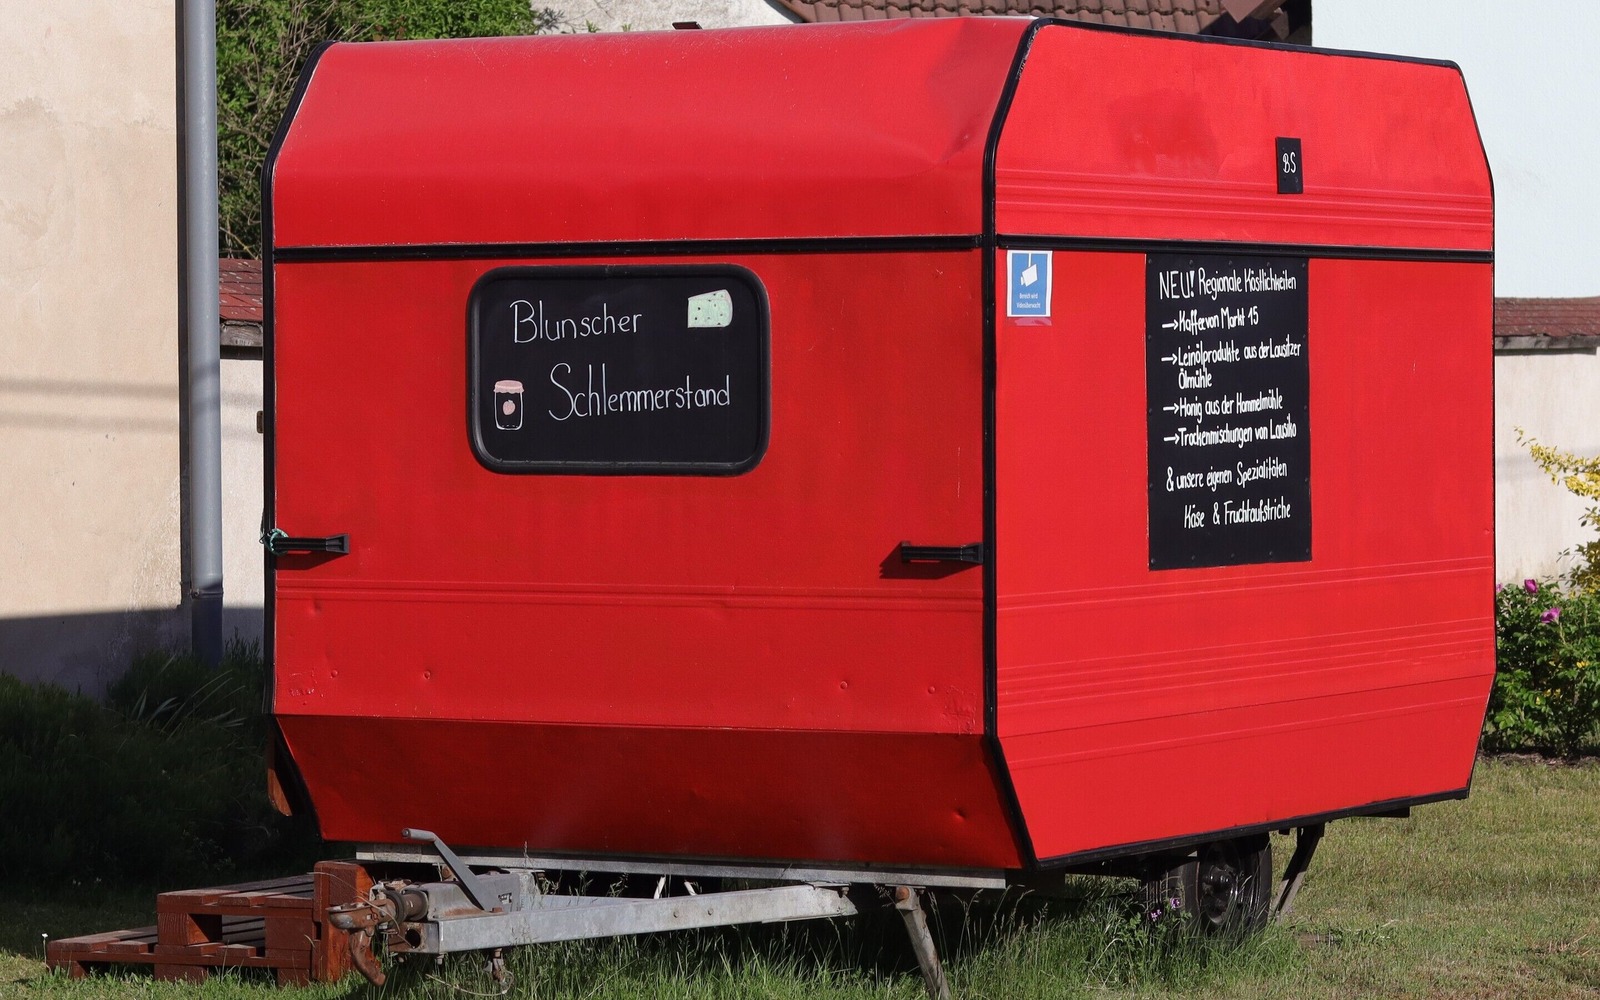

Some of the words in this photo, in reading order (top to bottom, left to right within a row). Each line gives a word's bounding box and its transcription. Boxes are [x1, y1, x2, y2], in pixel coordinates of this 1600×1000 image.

[1283, 152, 1296, 173] BS
[1159, 270, 1195, 299] NEU!
[1198, 267, 1242, 300] Regionale
[1244, 268, 1297, 292] Köstlichkeiten
[509, 299, 642, 343] Blunscher
[1221, 306, 1245, 330] Markt
[1248, 306, 1258, 326] 15
[1178, 340, 1240, 372] Leinölprodukte
[1244, 346, 1257, 360] aus
[1258, 341, 1269, 357] der
[1269, 334, 1301, 359] Lausitzer
[548, 362, 730, 421] Schlemmerstand
[1178, 368, 1212, 389] Ölmühle
[1179, 394, 1202, 424] Honig
[1205, 398, 1220, 415] aus
[1221, 395, 1233, 414] der
[1178, 423, 1252, 448] Trockenmischungen
[1255, 427, 1268, 440] von
[1166, 466, 1174, 491] &
[1176, 470, 1204, 490] unsere
[1206, 467, 1232, 492] eigenen
[1237, 457, 1287, 488] Spezialitäten
[1184, 504, 1205, 529] Käse
[1213, 502, 1220, 525] &
[1224, 496, 1291, 525] Fruchtaufstriche
